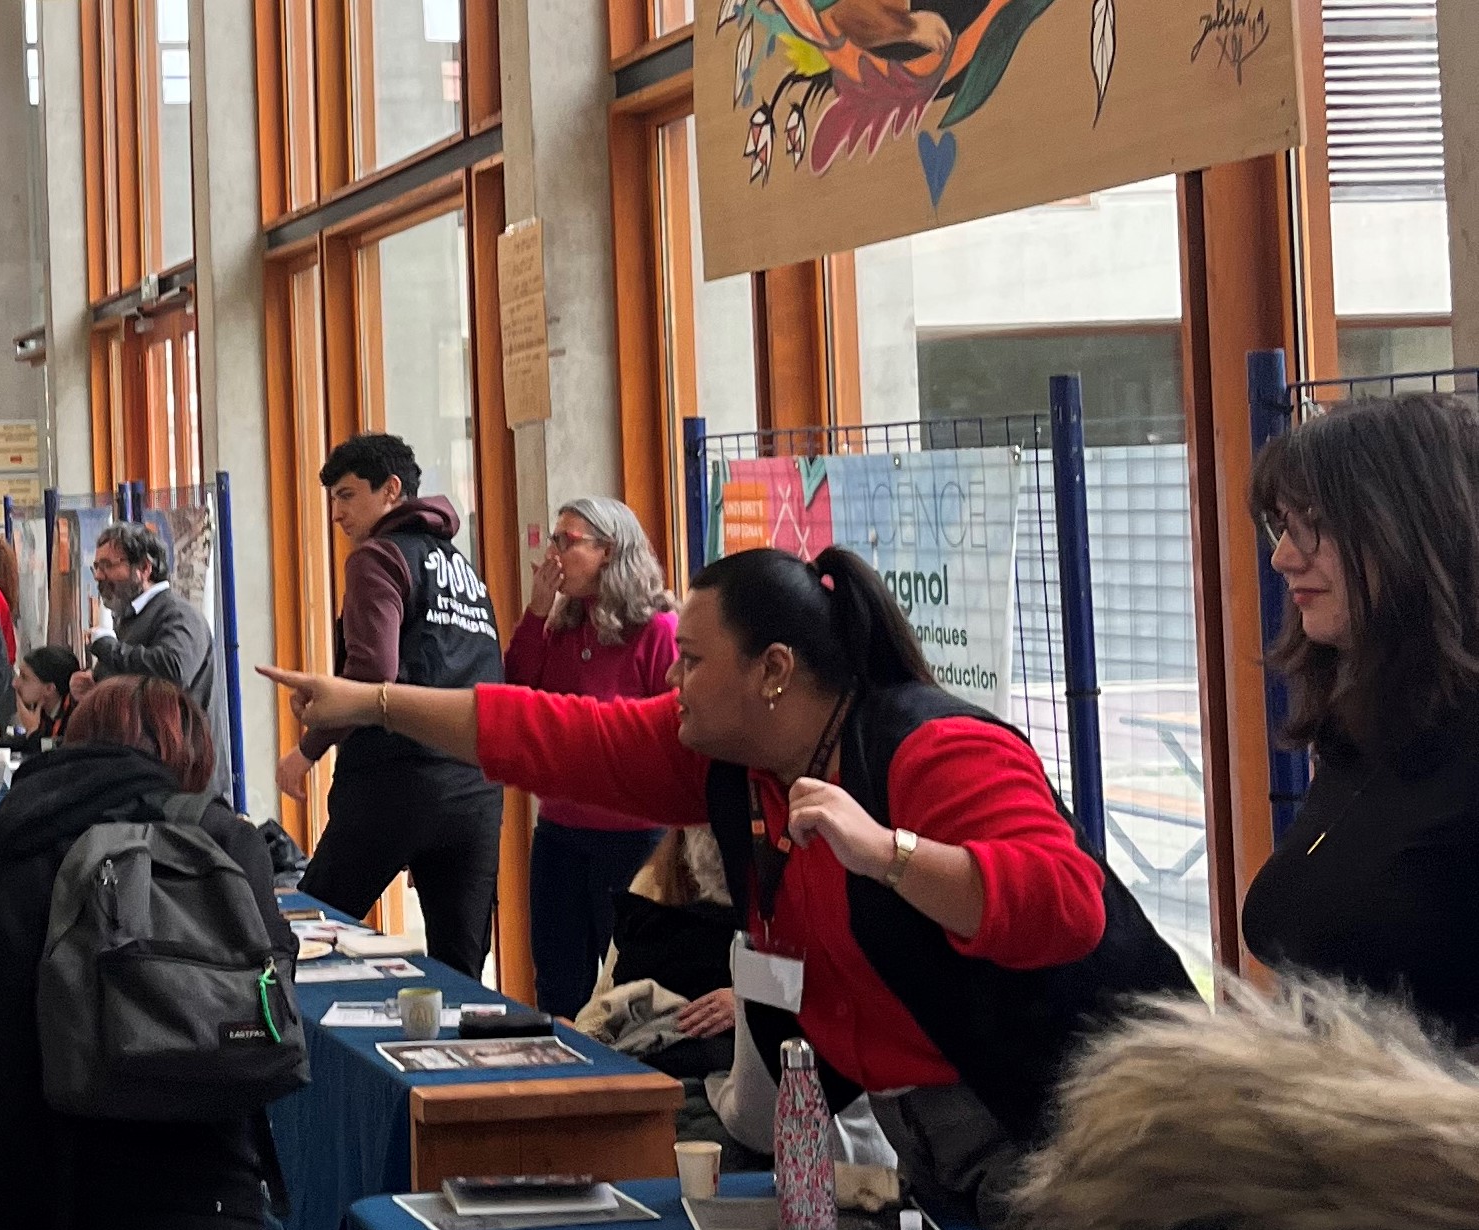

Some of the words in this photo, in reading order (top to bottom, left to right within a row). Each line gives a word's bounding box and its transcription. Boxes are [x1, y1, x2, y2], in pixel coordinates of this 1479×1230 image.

[843, 481, 987, 548] LICENCE
[877, 564, 949, 618] agnol
[914, 619, 968, 649] aniques
[930, 661, 998, 690] raduction
